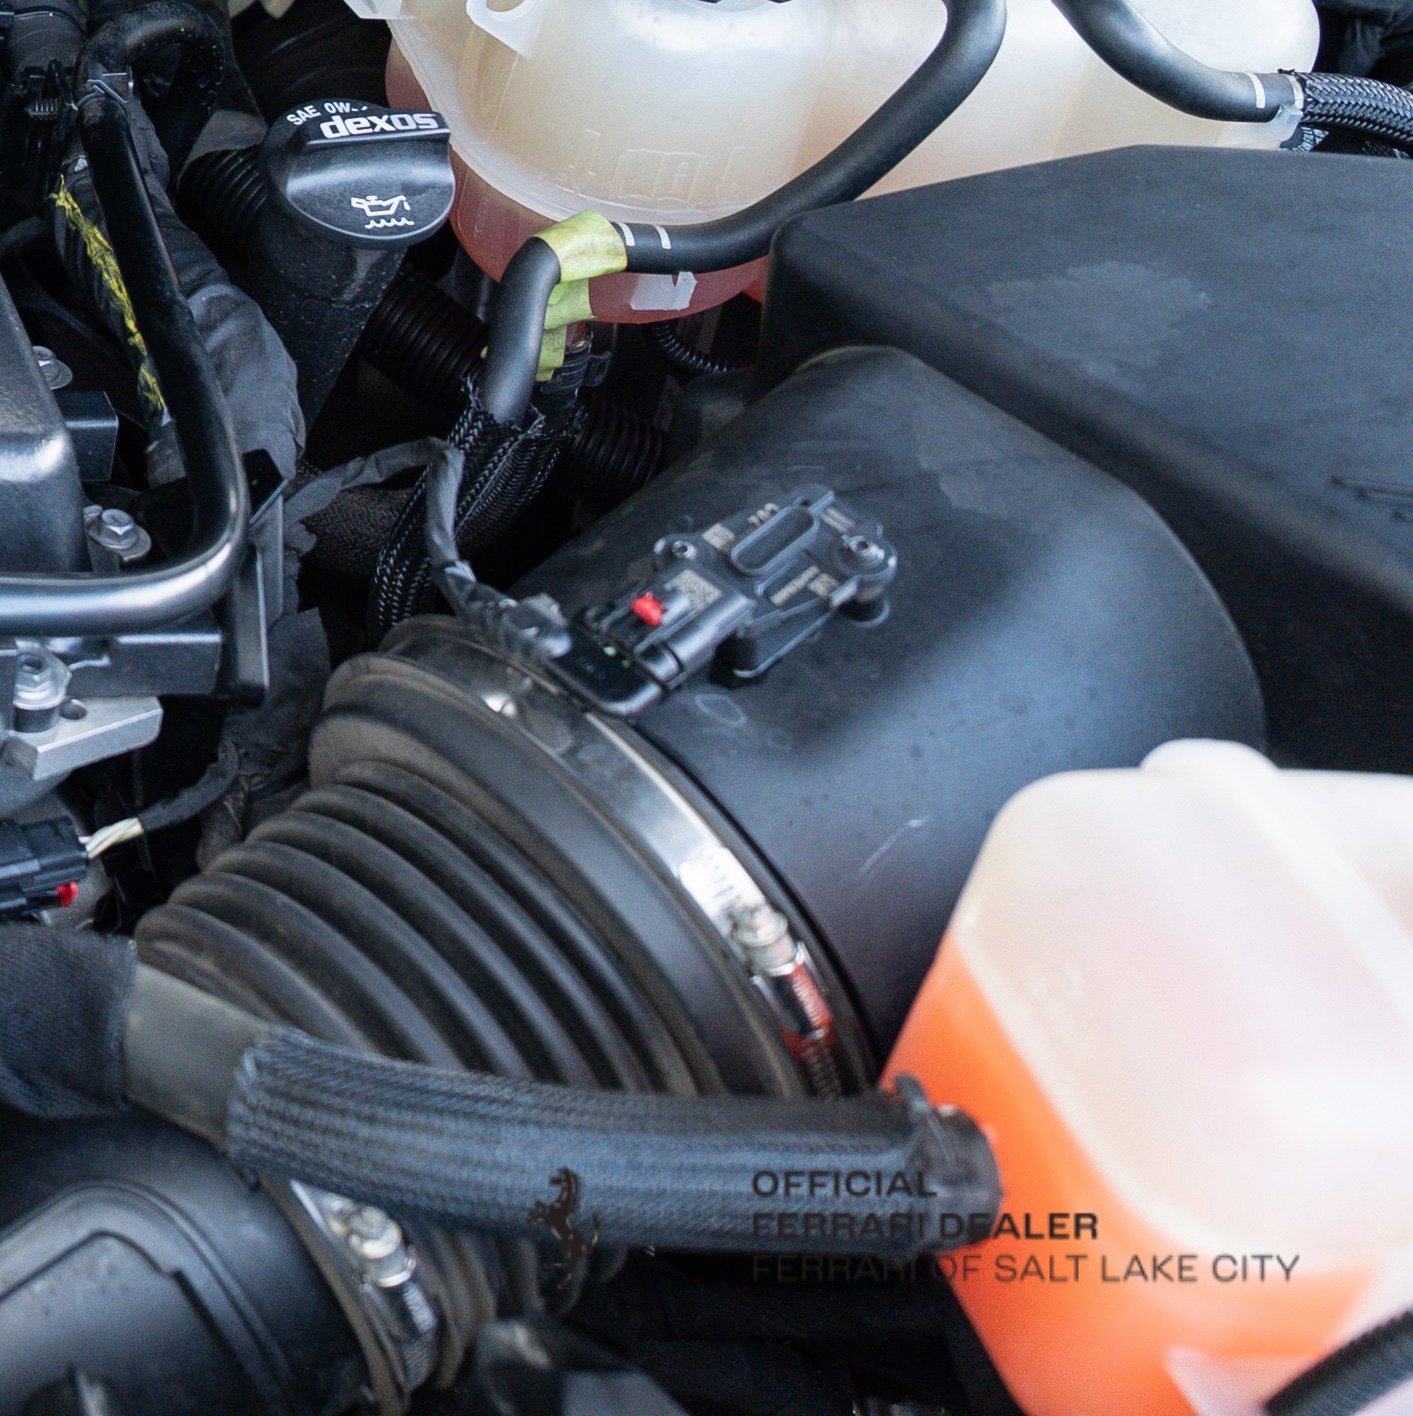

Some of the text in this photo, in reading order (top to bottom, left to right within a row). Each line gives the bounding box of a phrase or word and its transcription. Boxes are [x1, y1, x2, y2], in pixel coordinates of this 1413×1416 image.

[287, 102, 368, 126] SAE 0W-
[320, 113, 439, 139] dexos
